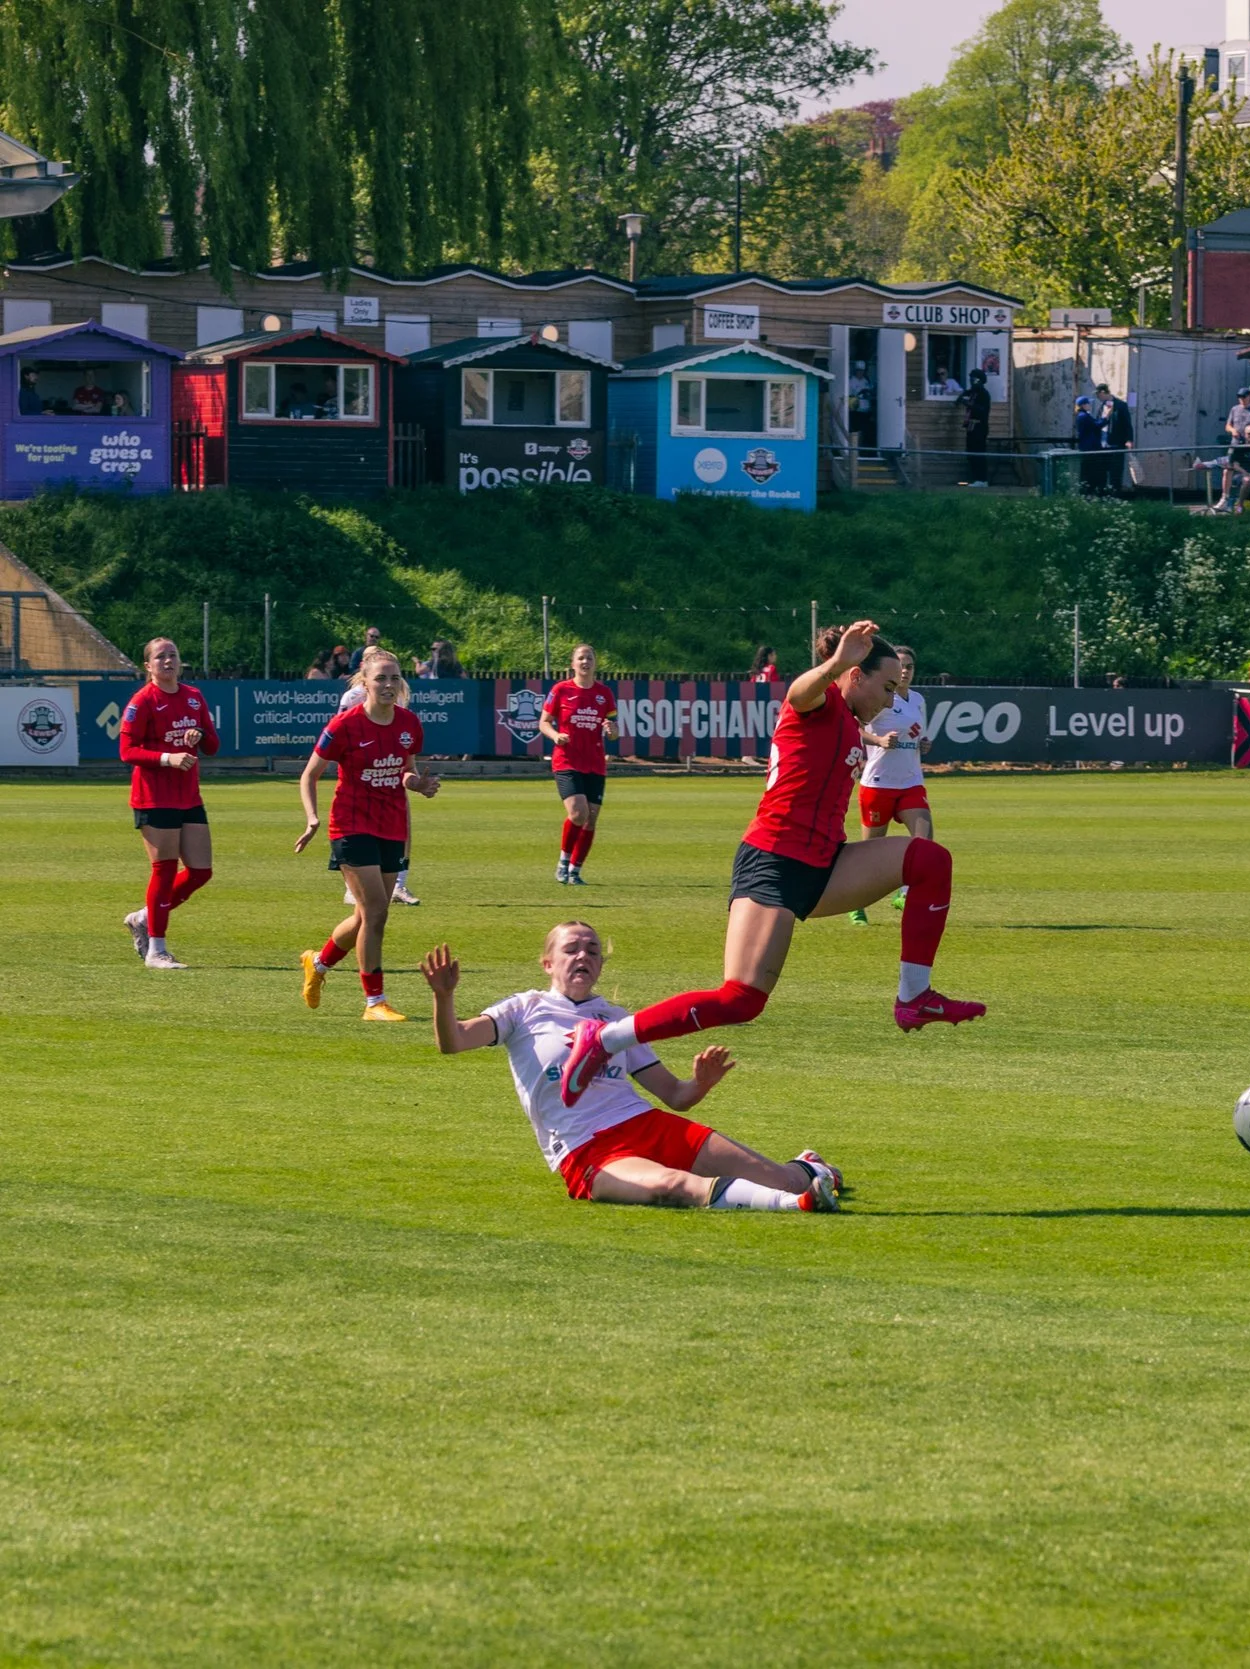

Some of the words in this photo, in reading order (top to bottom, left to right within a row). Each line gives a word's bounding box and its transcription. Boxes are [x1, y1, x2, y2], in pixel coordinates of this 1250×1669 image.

[353, 308, 369, 316] Only
[905, 305, 943, 323] CLUB
[950, 307, 990, 325] SHOP
[708, 314, 735, 329] COFFEE
[736, 315, 756, 330] SHOP
[102, 431, 141, 447] who
[15, 444, 42, 453] We're
[28, 453, 42, 462] for
[43, 454, 65, 464] you!
[89, 448, 138, 464] gives
[140, 449, 153, 460] a
[459, 453, 479, 464] It's
[459, 461, 593, 494] possible
[253, 690, 340, 707] World-leading
[253, 710, 335, 724] critical-comm
[577, 707, 599, 717] who
[172, 716, 197, 729] who
[507, 719, 541, 730] LEWE
[576, 721, 597, 731] crap
[1049, 705, 1134, 737] Level
[1144, 711, 1184, 745] up
[255, 733, 316, 745] zenitel.com
[373, 754, 404, 768] who
[371, 775, 400, 789] crap
